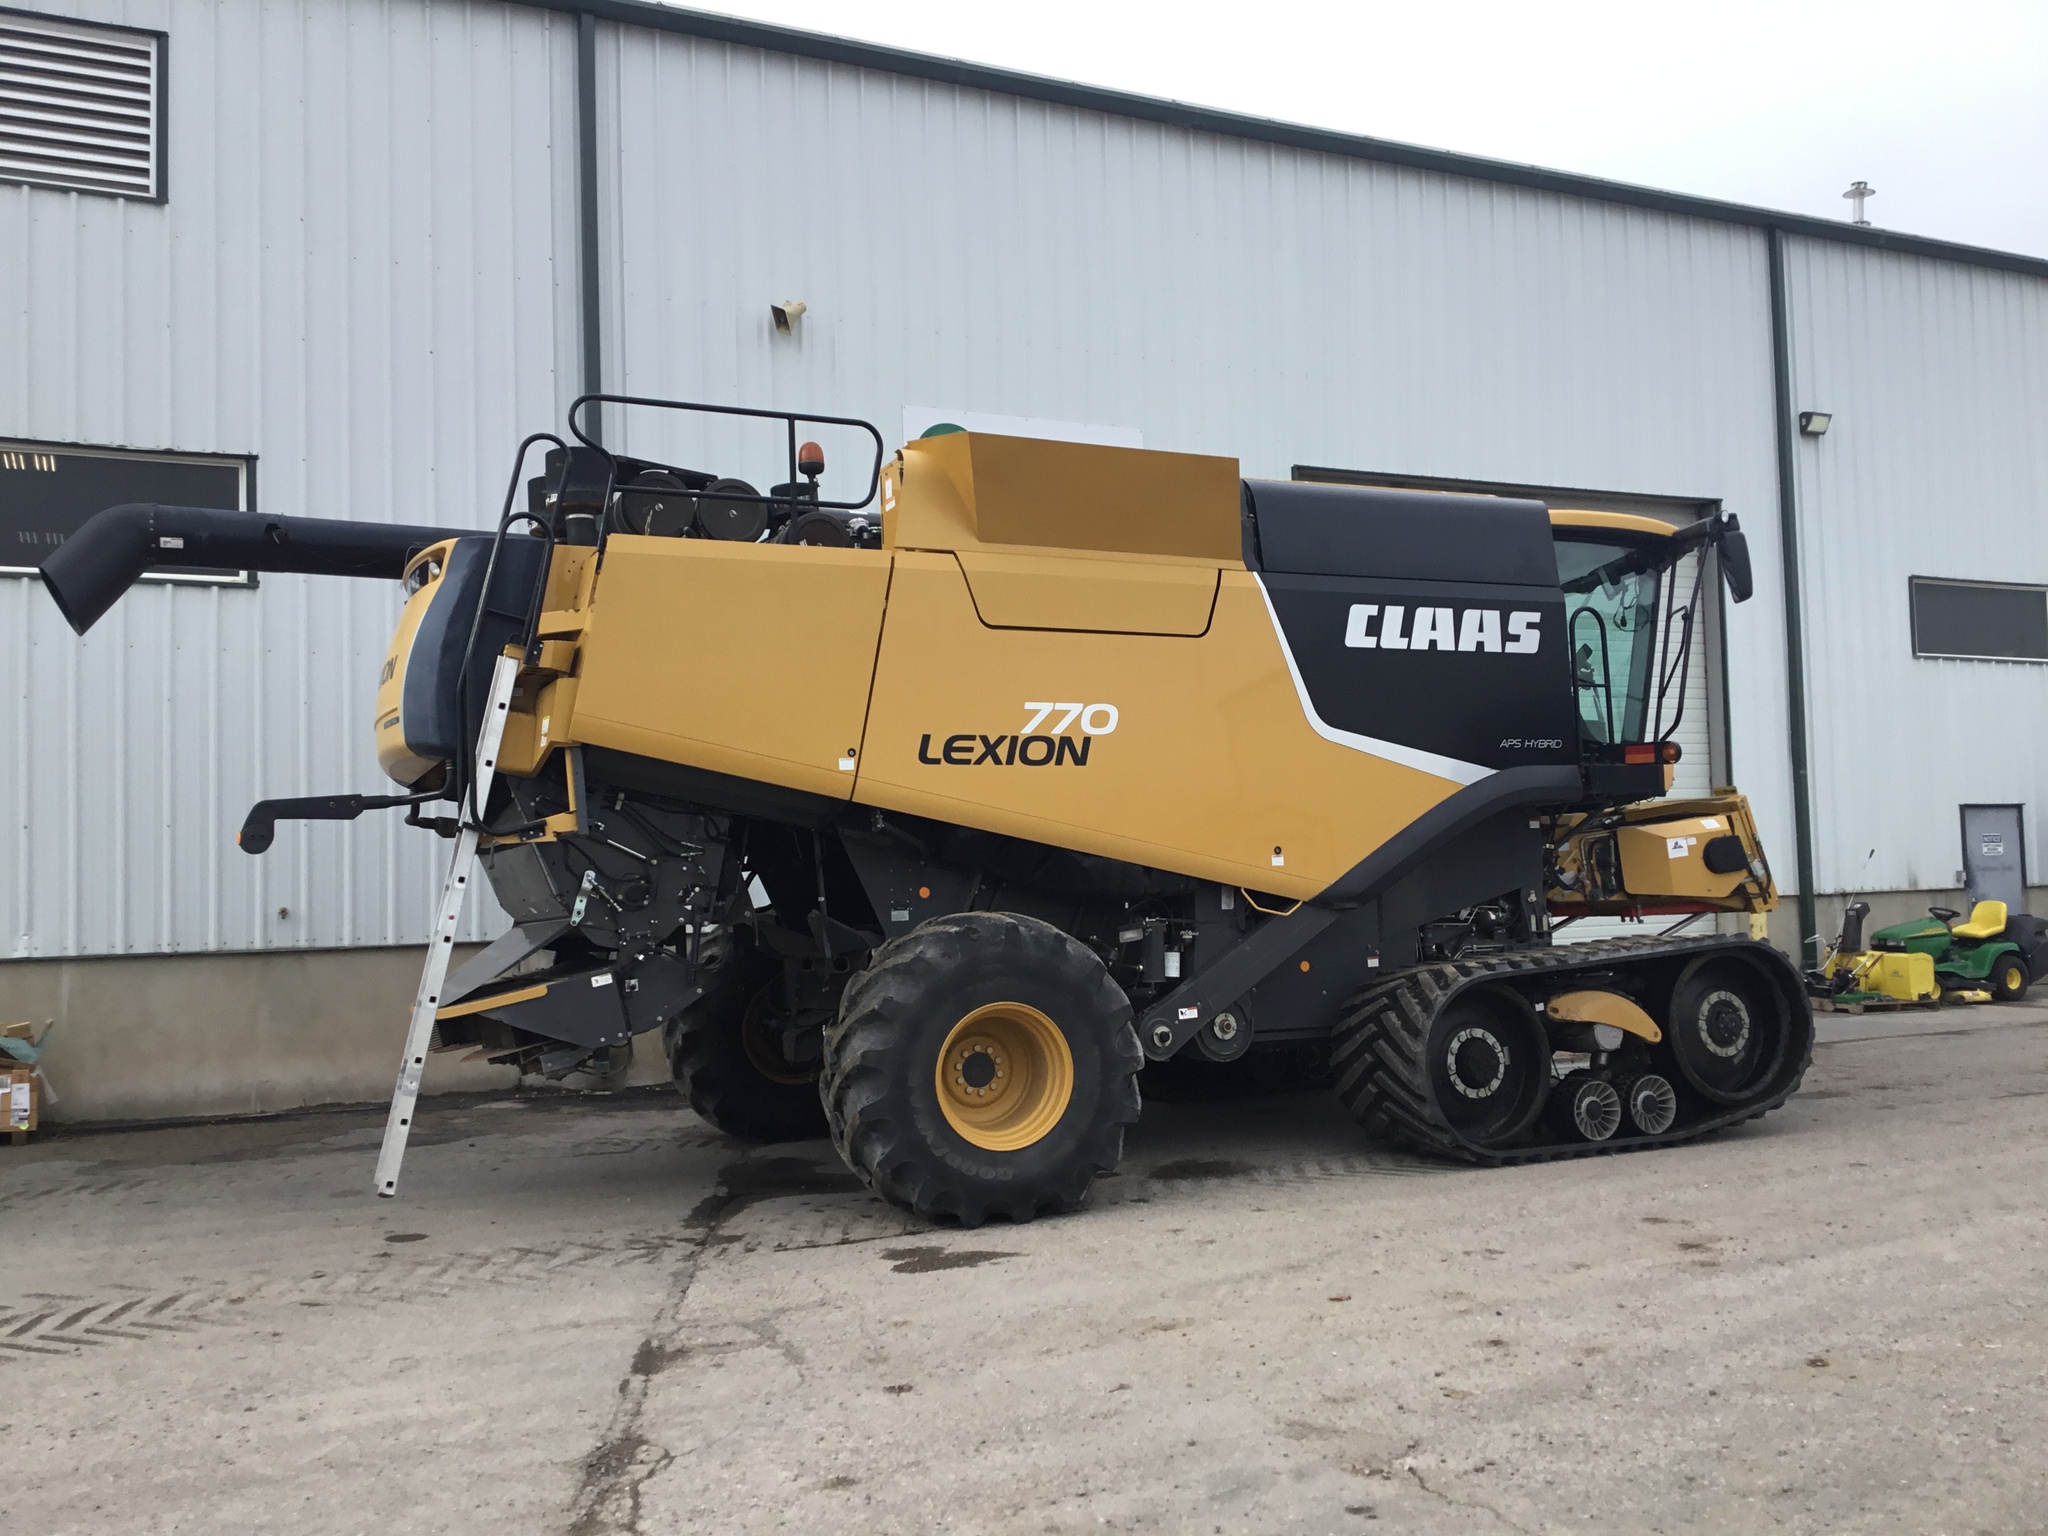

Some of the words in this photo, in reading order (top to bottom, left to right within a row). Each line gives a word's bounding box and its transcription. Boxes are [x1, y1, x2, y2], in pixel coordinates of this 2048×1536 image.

[1345, 604, 1542, 654] CLAAS
[1020, 702, 1119, 735] 770
[918, 734, 1092, 766] LEXION
[1499, 738, 1522, 748] APS
[1524, 739, 1563, 749] HYBRID
